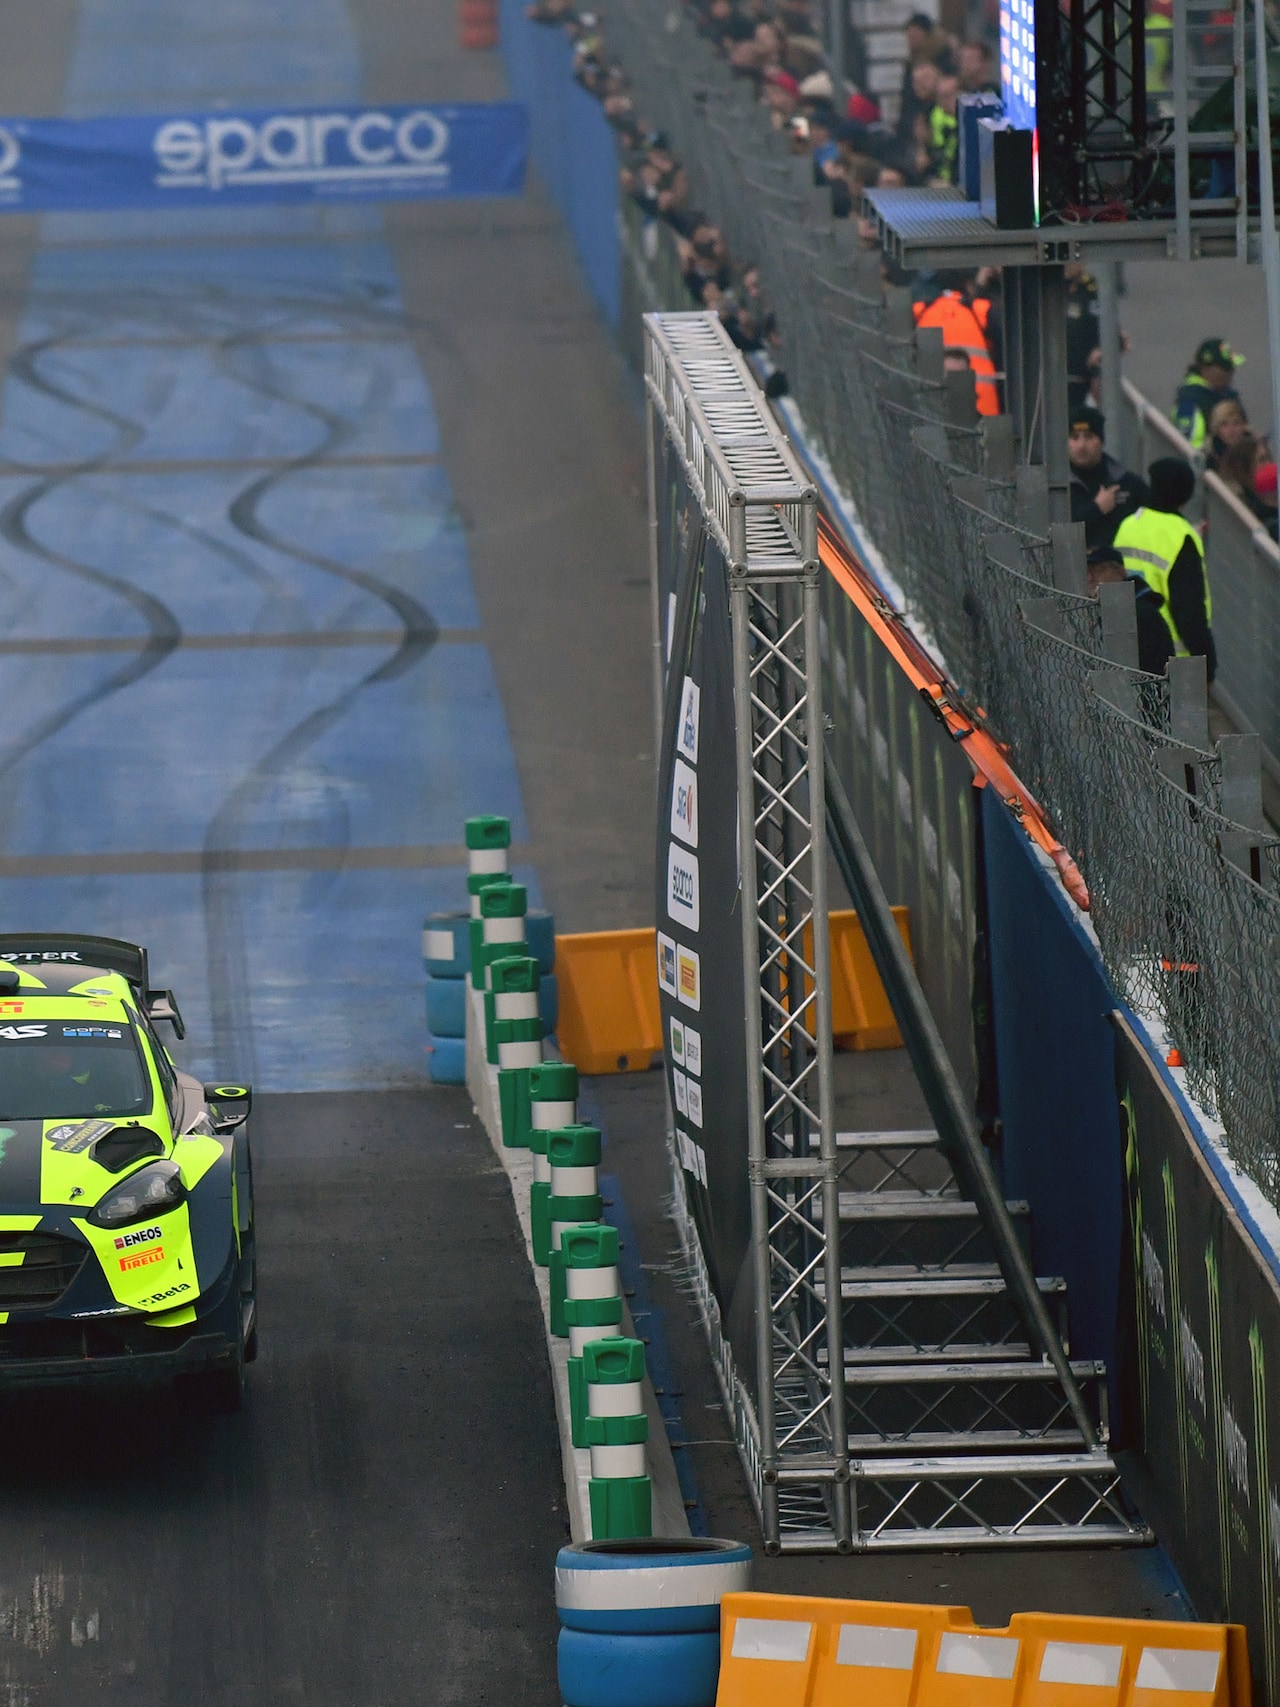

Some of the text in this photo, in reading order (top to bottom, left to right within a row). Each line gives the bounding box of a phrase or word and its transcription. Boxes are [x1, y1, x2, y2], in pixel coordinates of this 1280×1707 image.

[153, 110, 450, 189] sparco
[123, 1226, 162, 1247] ENEOS
[119, 1246, 165, 1272] PIRELLI
[151, 1283, 191, 1304] Beta
